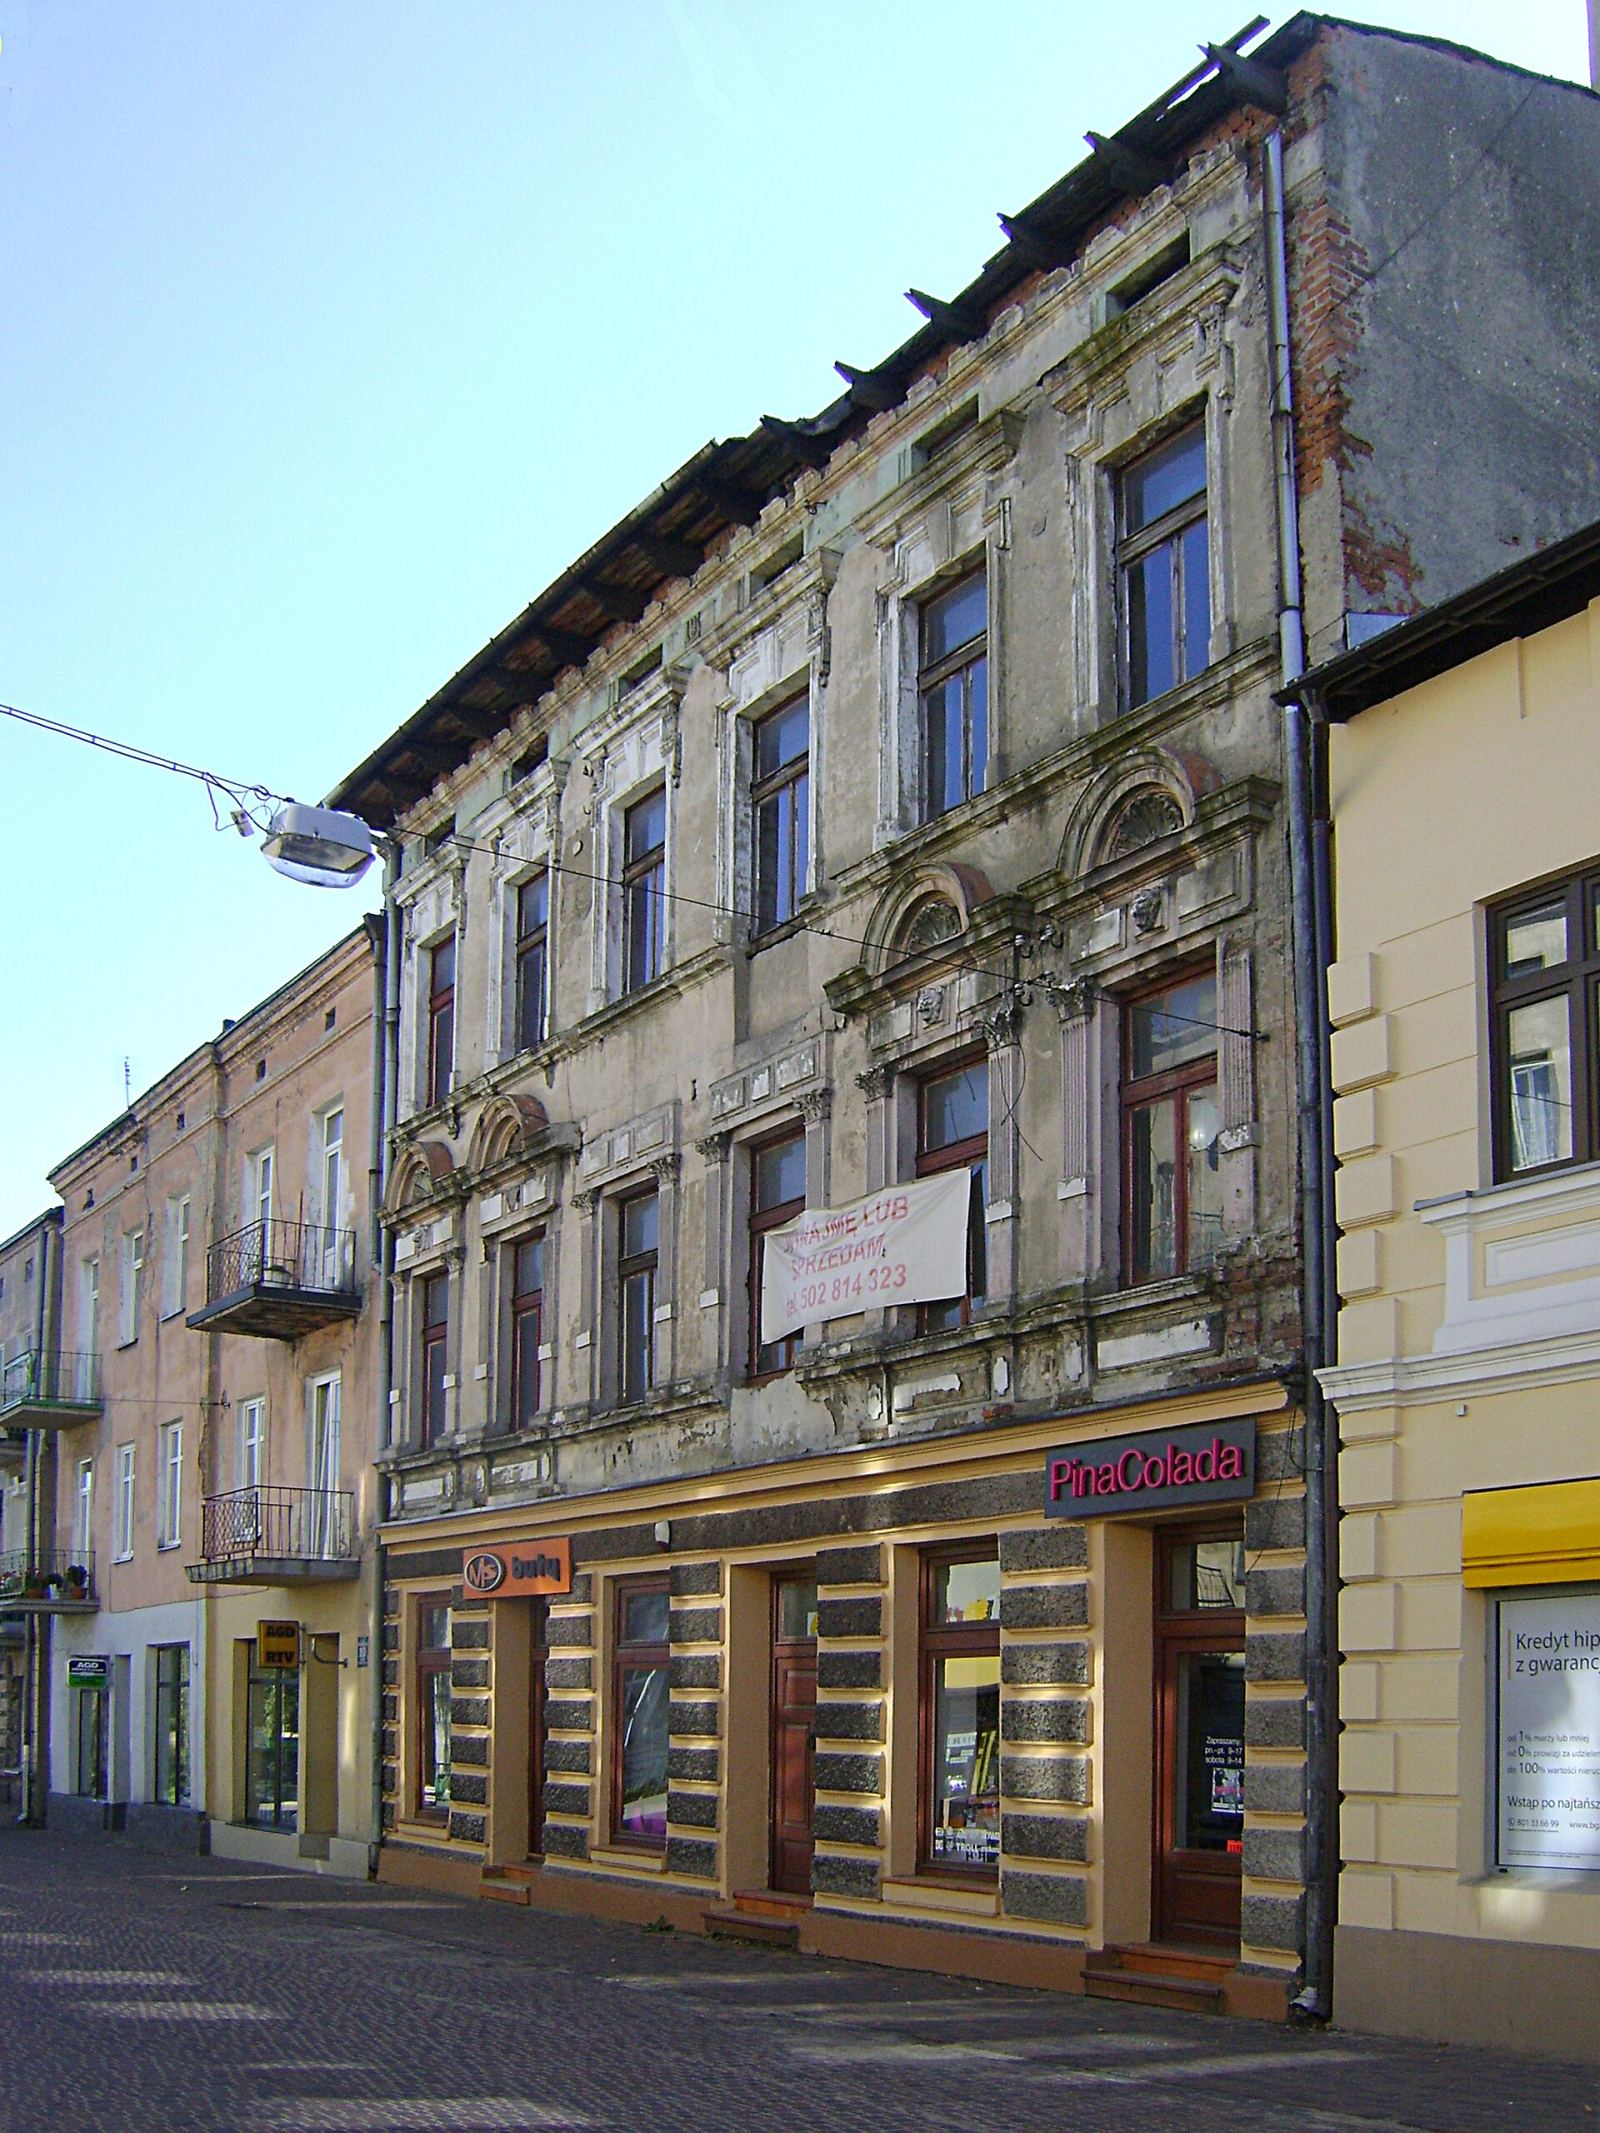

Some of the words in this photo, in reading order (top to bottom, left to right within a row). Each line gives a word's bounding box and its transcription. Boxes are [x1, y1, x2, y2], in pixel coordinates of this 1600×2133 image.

[862, 1195, 909, 1228] LUB
[791, 1232, 886, 1281] SPRZEDAM
[800, 1282, 826, 1309] 502
[831, 1272, 862, 1301] 814
[868, 1263, 907, 1292] 323
[1049, 1437, 1245, 1501] PinaColada
[511, 1553, 561, 1583] buty
[266, 1625, 295, 1638] AGD
[1516, 1631, 1569, 1652] Kredyt
[76, 1661, 99, 1669] AGD
[266, 1651, 294, 1663] RTV
[1516, 1660, 1524, 1672] z
[1528, 1656, 1600, 1676] gwaranc
[1556, 1733, 1568, 1742] lub
[1569, 1734, 1589, 1743] mniej
[1519, 1762, 1546, 1774] 100%
[1507, 1796, 1539, 1810] Wstąp
[1541, 1799, 1556, 1810] po
[1517, 1819, 1529, 1827] 801
